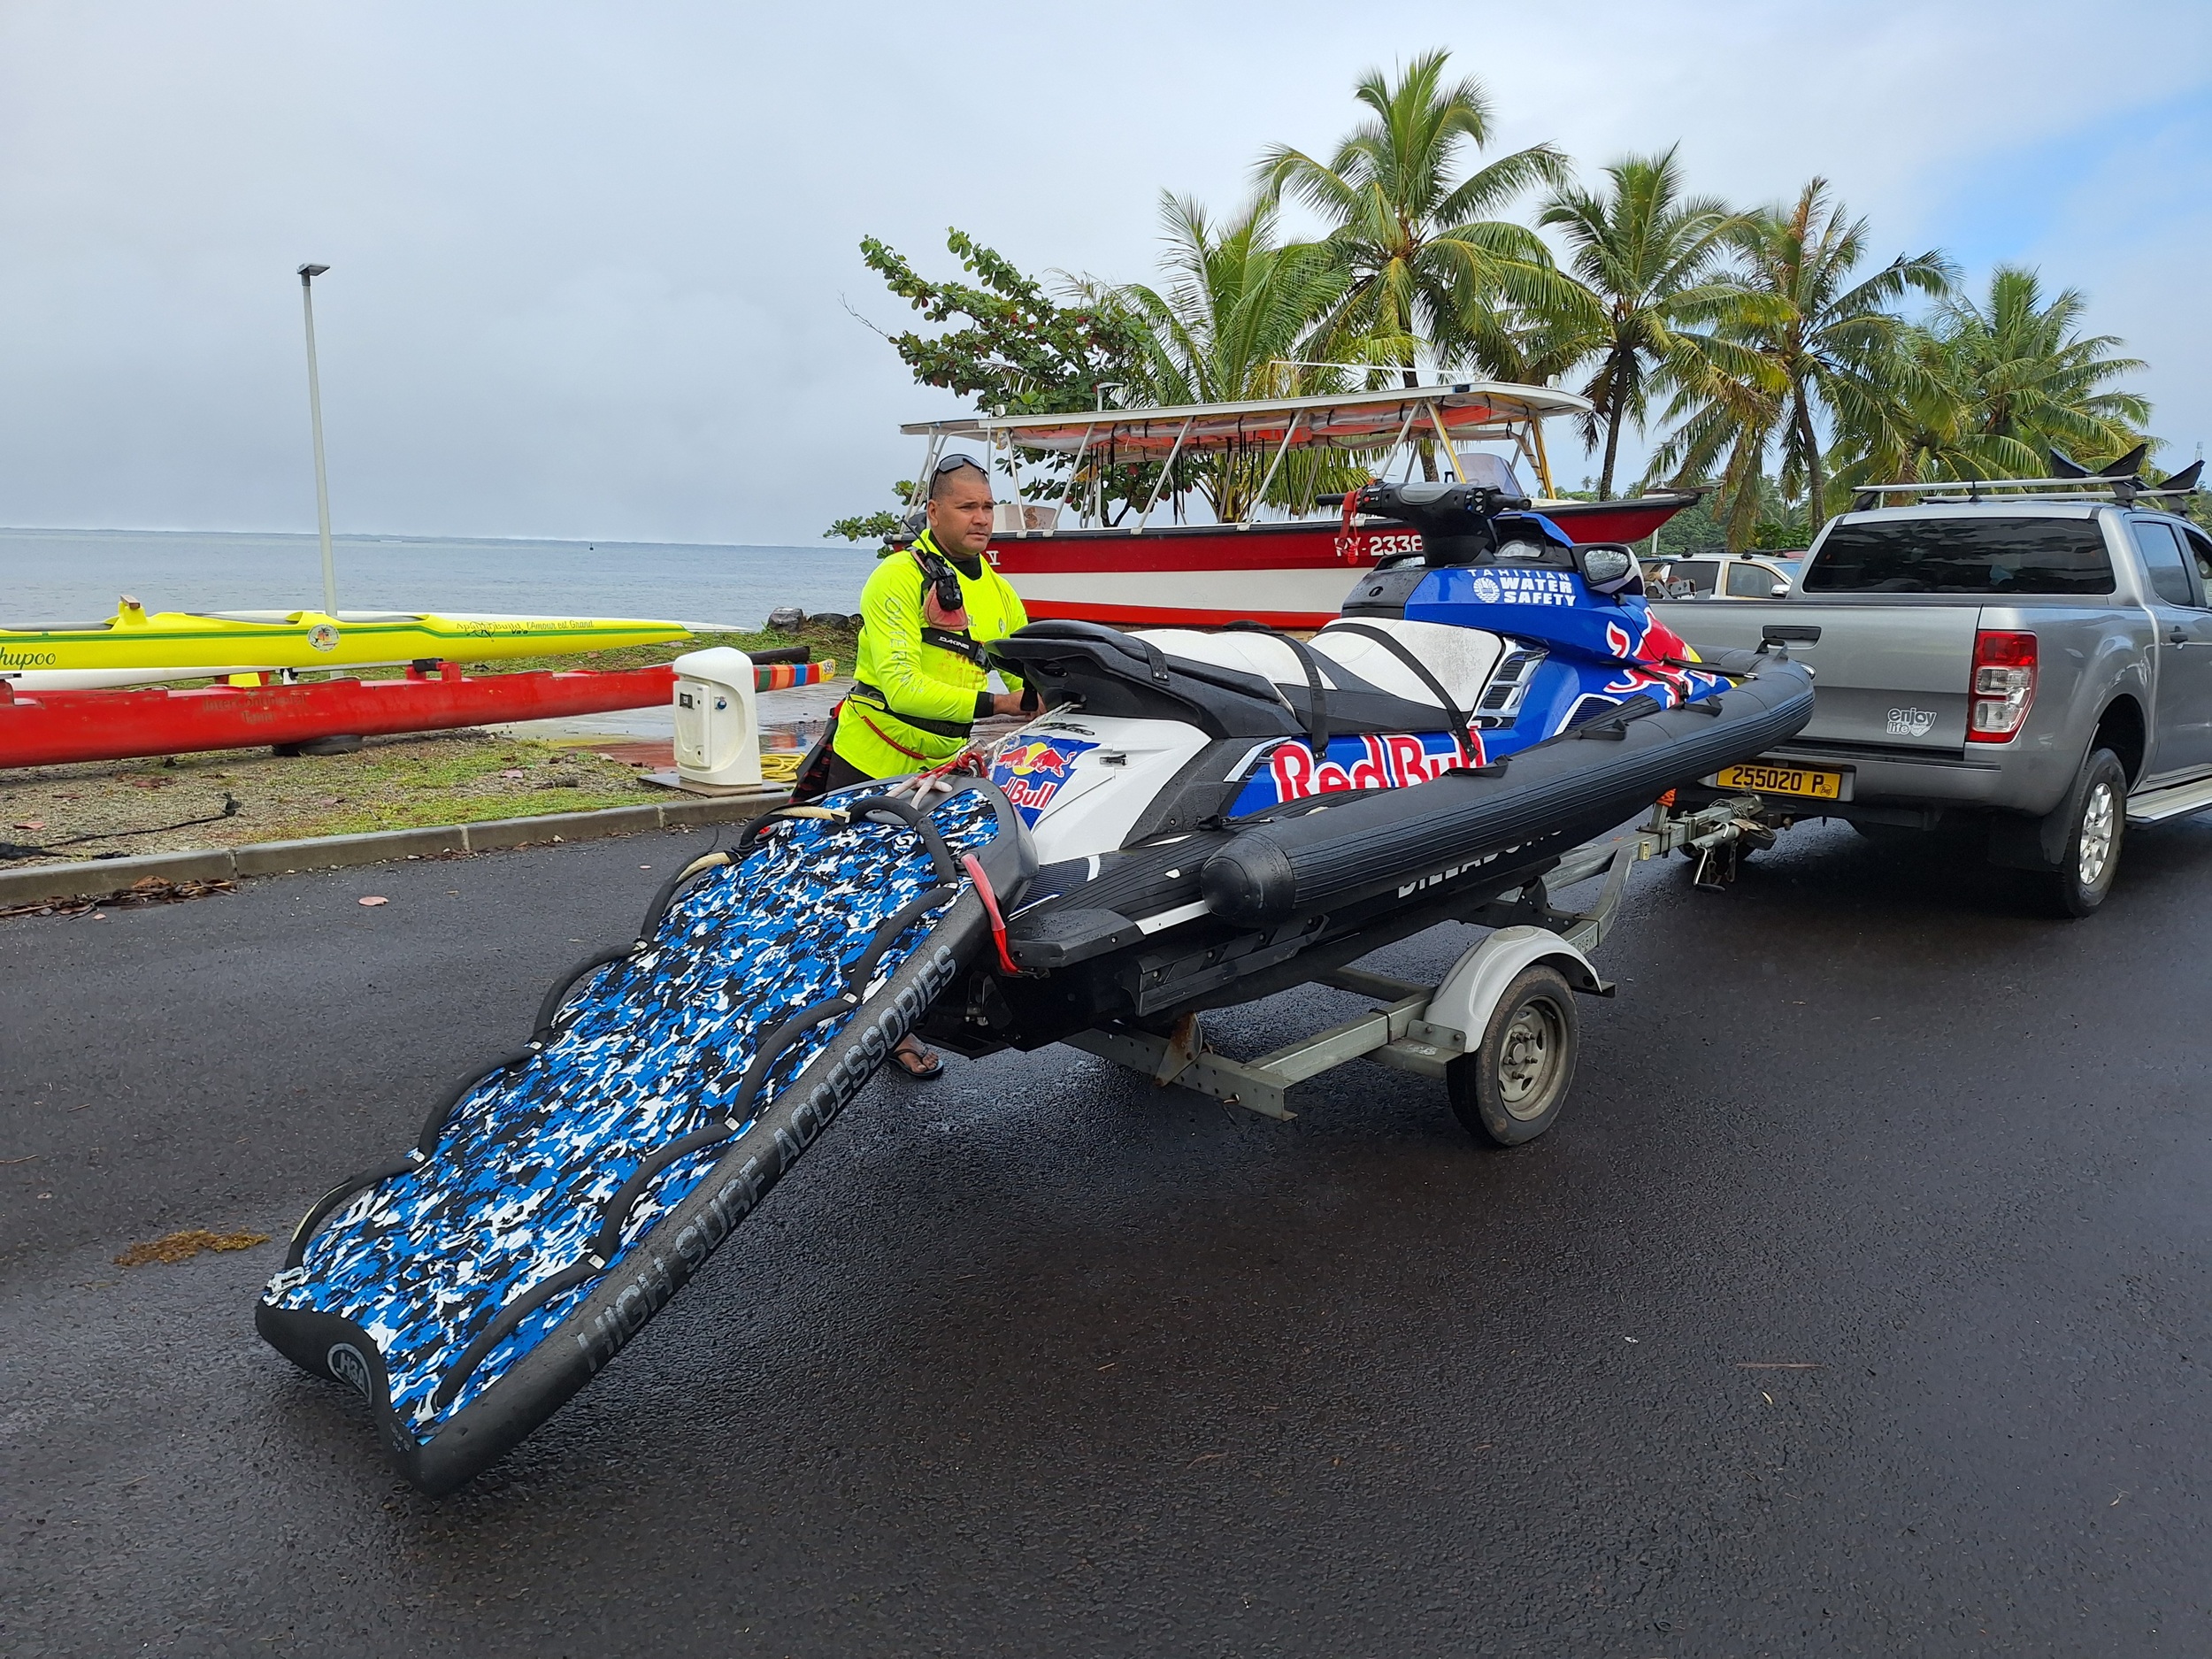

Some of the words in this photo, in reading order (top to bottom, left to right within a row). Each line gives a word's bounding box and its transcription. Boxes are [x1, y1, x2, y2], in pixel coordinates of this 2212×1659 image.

[1467, 569, 1571, 581] TAHITIAN
[1500, 577, 1572, 594] WATER
[1504, 591, 1576, 607] SAFETY
[1888, 708, 1937, 726] enjoy
[1887, 721, 1909, 734] life
[1732, 766, 1802, 791] 255020
[1811, 774, 1824, 793] P
[577, 1257, 674, 1371] HIGH
[675, 1156, 765, 1273] SURF
[773, 945, 956, 1174] ACCESSORIES
